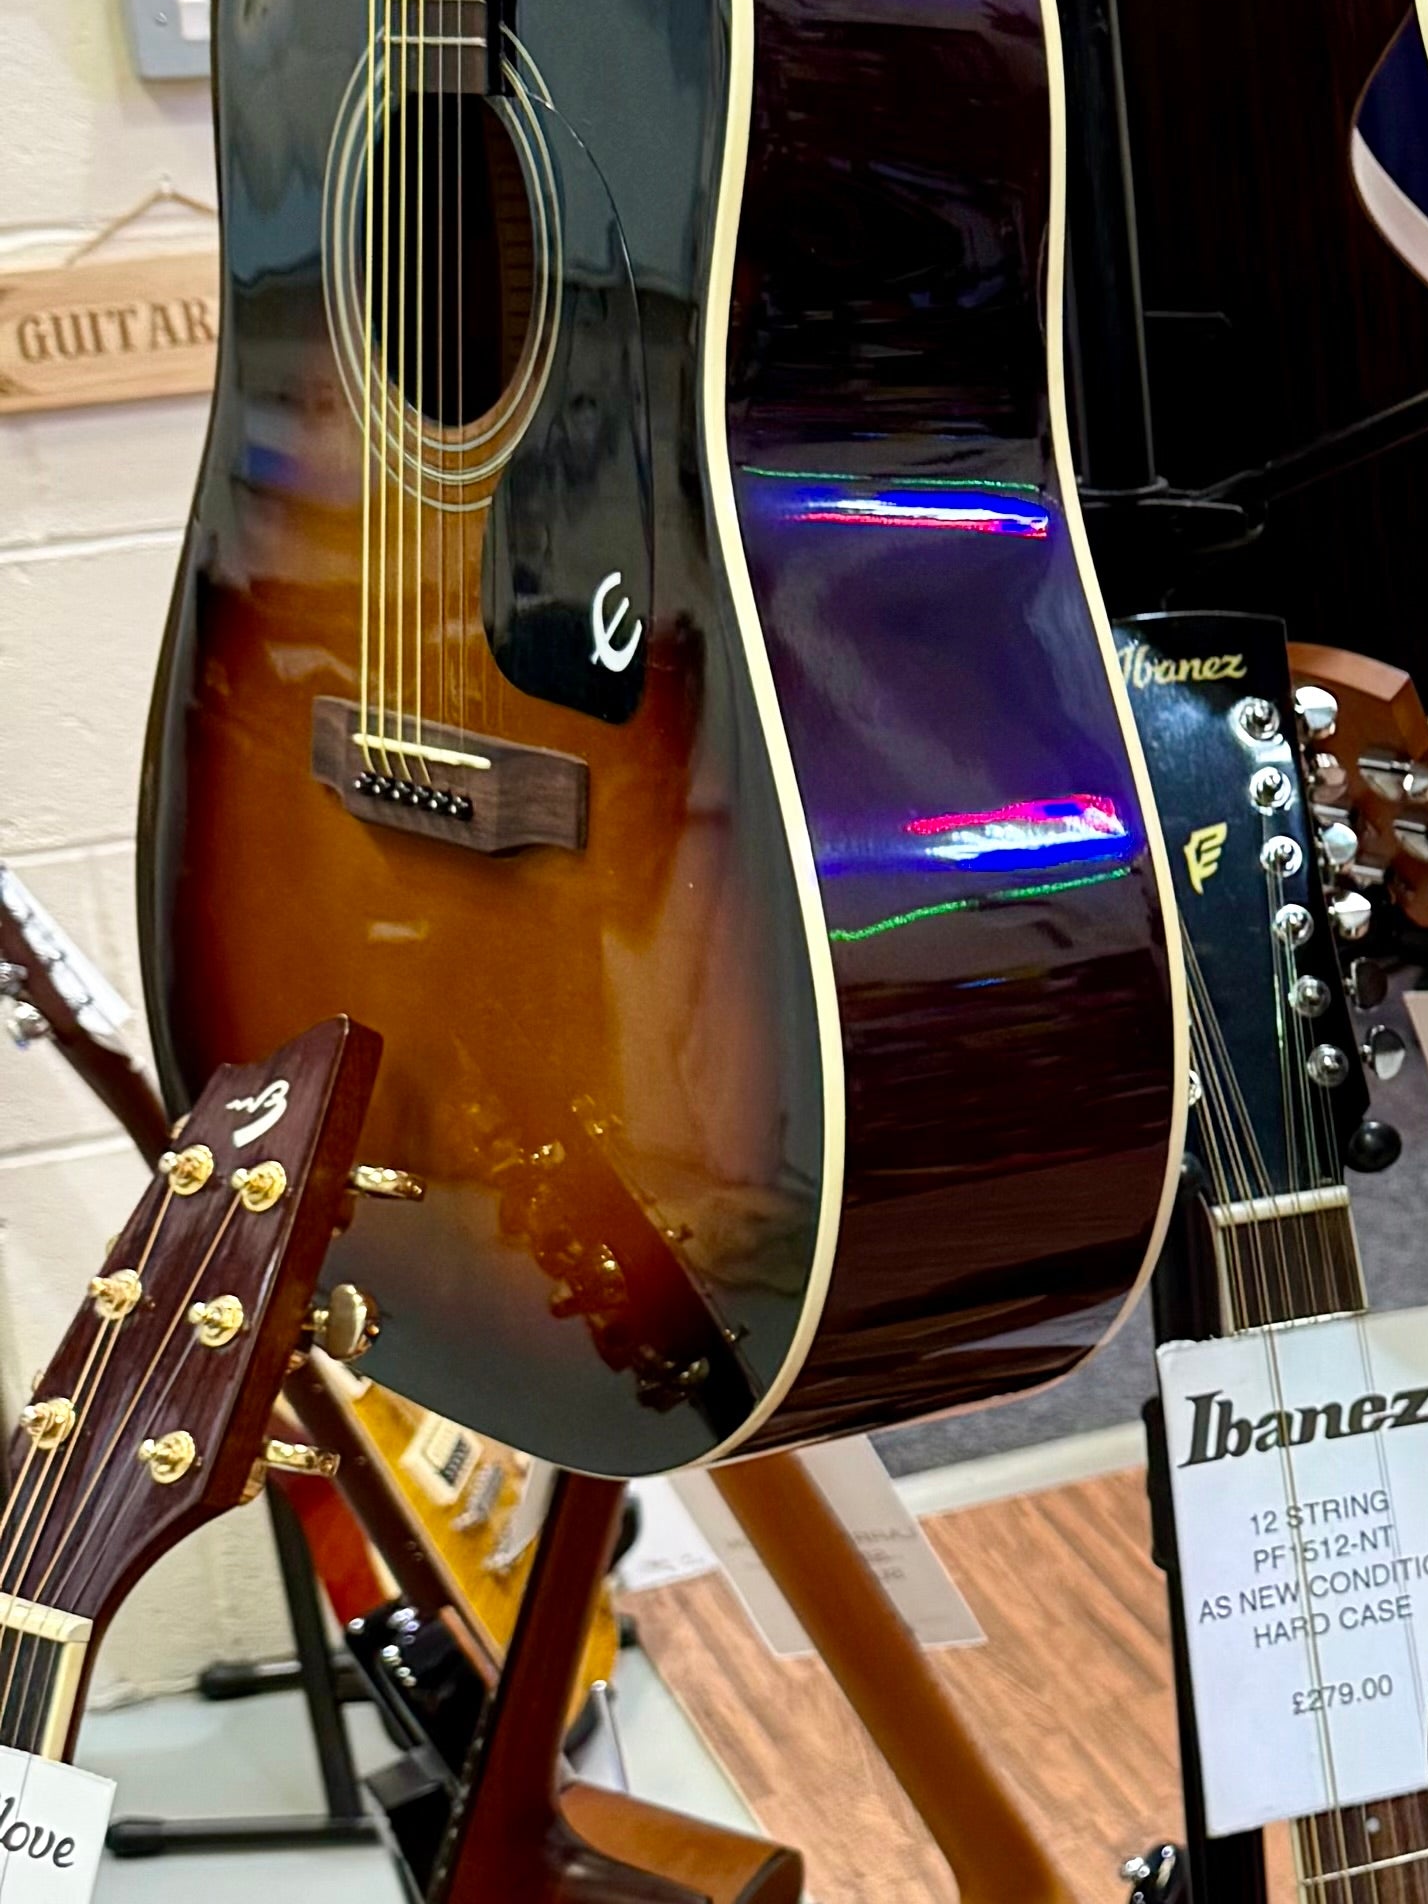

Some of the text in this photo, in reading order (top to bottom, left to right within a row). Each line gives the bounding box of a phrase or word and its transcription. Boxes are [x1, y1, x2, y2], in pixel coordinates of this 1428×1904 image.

[16, 297, 217, 364] GUITAR
[1119, 645, 1248, 689] Ibanez
[1249, 1489, 1390, 1536] 12 STRING
[1253, 1525, 1395, 1573] PF1512-NT
[1199, 1595, 1232, 1625] AS
[1239, 1580, 1301, 1616] NEW
[1253, 1595, 1413, 1649] HARD CASE
[1291, 1674, 1394, 1716] £279.00
[0, 1796, 75, 1869] love
